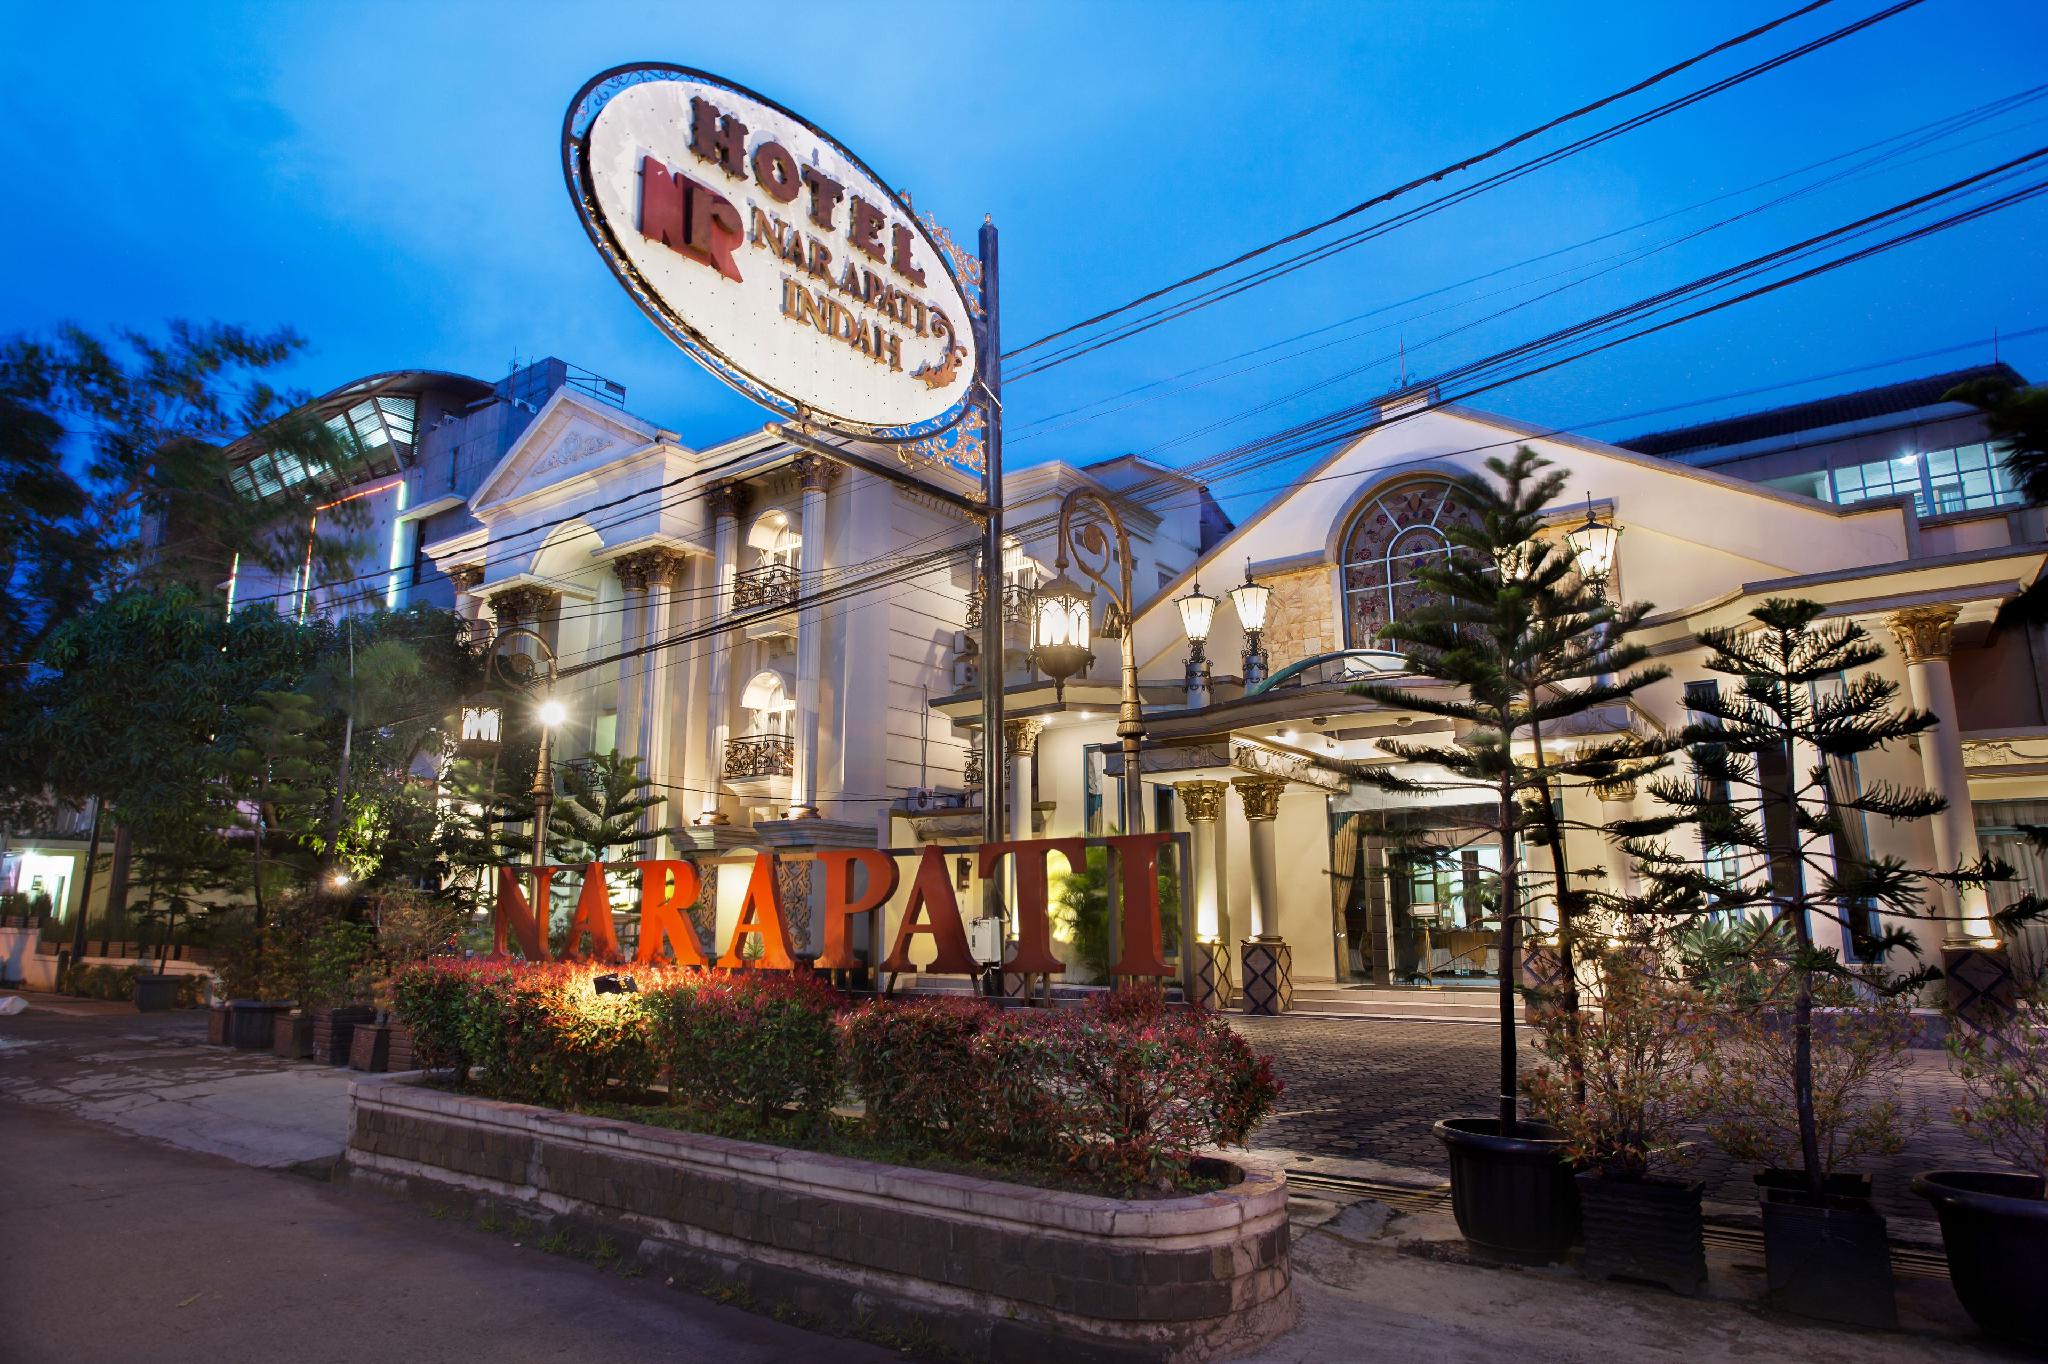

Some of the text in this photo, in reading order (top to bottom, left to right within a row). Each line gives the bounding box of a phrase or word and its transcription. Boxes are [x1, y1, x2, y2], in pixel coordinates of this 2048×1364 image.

[688, 95, 928, 289] HOTEL
[750, 206, 930, 338] NARAPATI
[782, 277, 904, 372] INDAH
[488, 832, 1176, 976] NARAPATI
